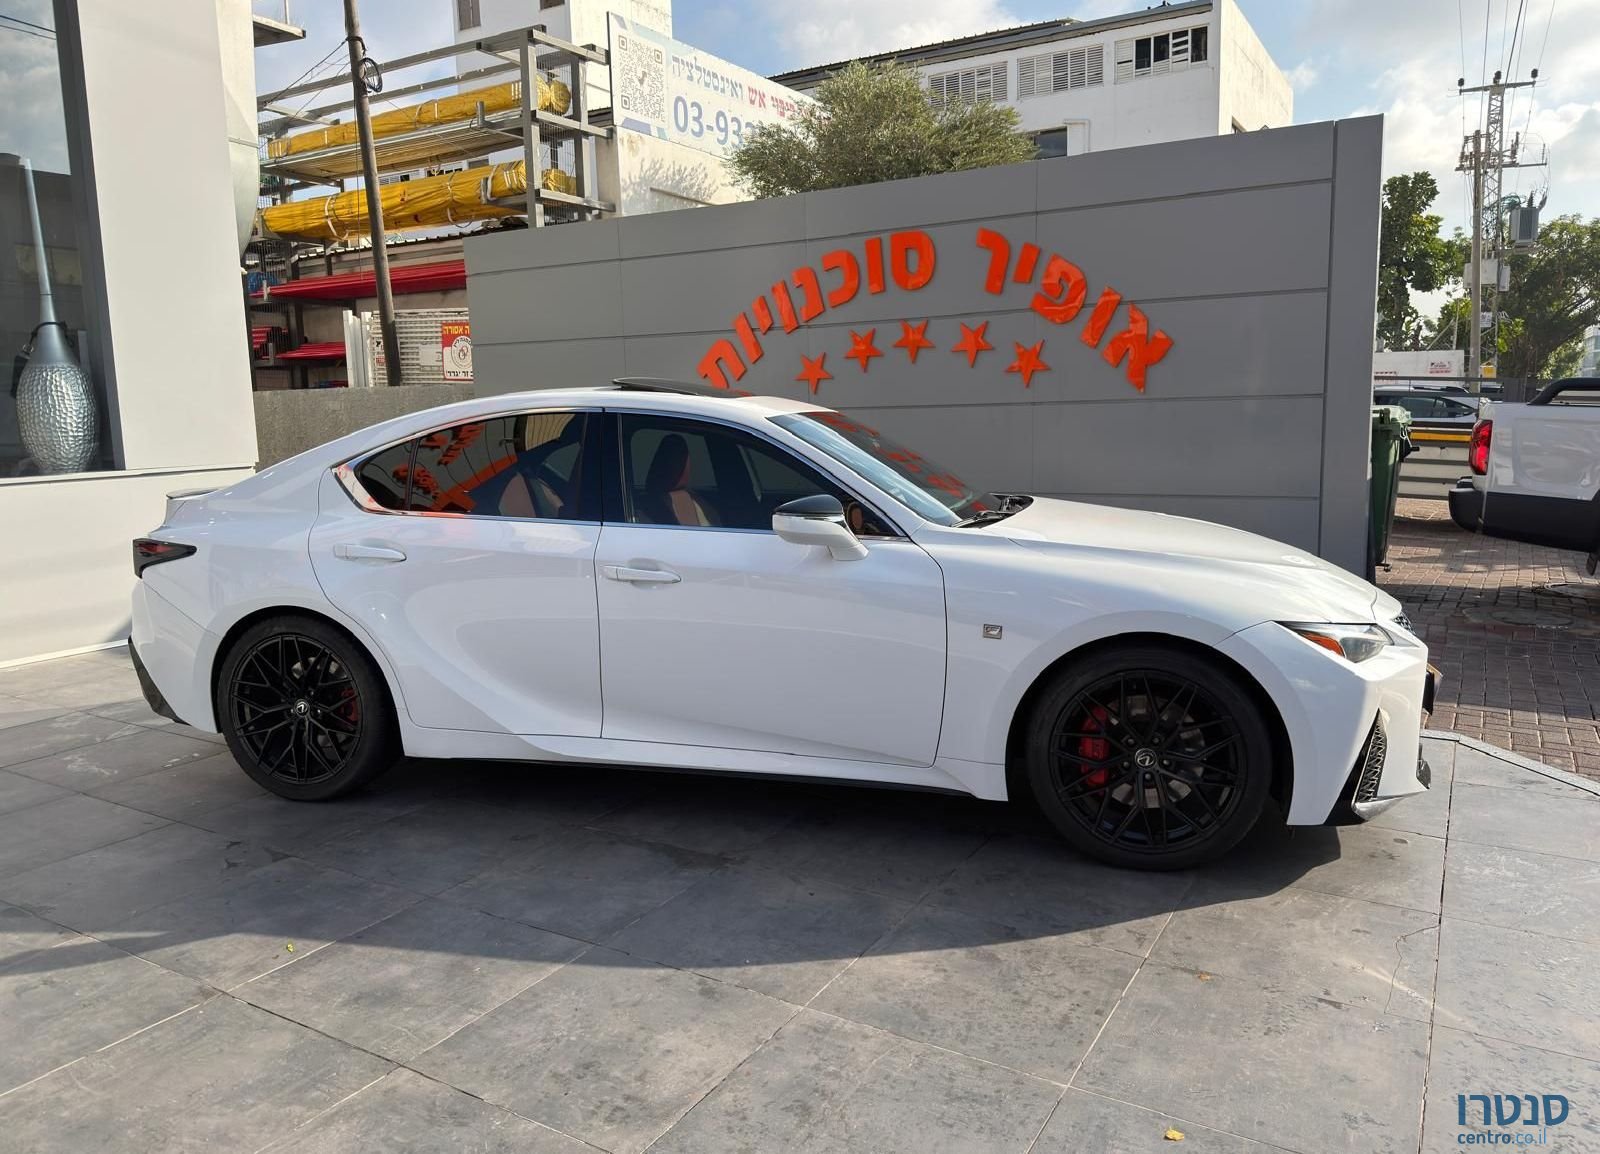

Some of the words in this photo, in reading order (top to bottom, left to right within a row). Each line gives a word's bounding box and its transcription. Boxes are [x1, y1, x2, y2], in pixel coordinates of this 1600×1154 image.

[671, 55, 744, 101] ואינסטלציה
[747, 86, 766, 109] אש
[697, 229, 936, 389] סוכנויות
[976, 227, 1175, 393] אופיר
